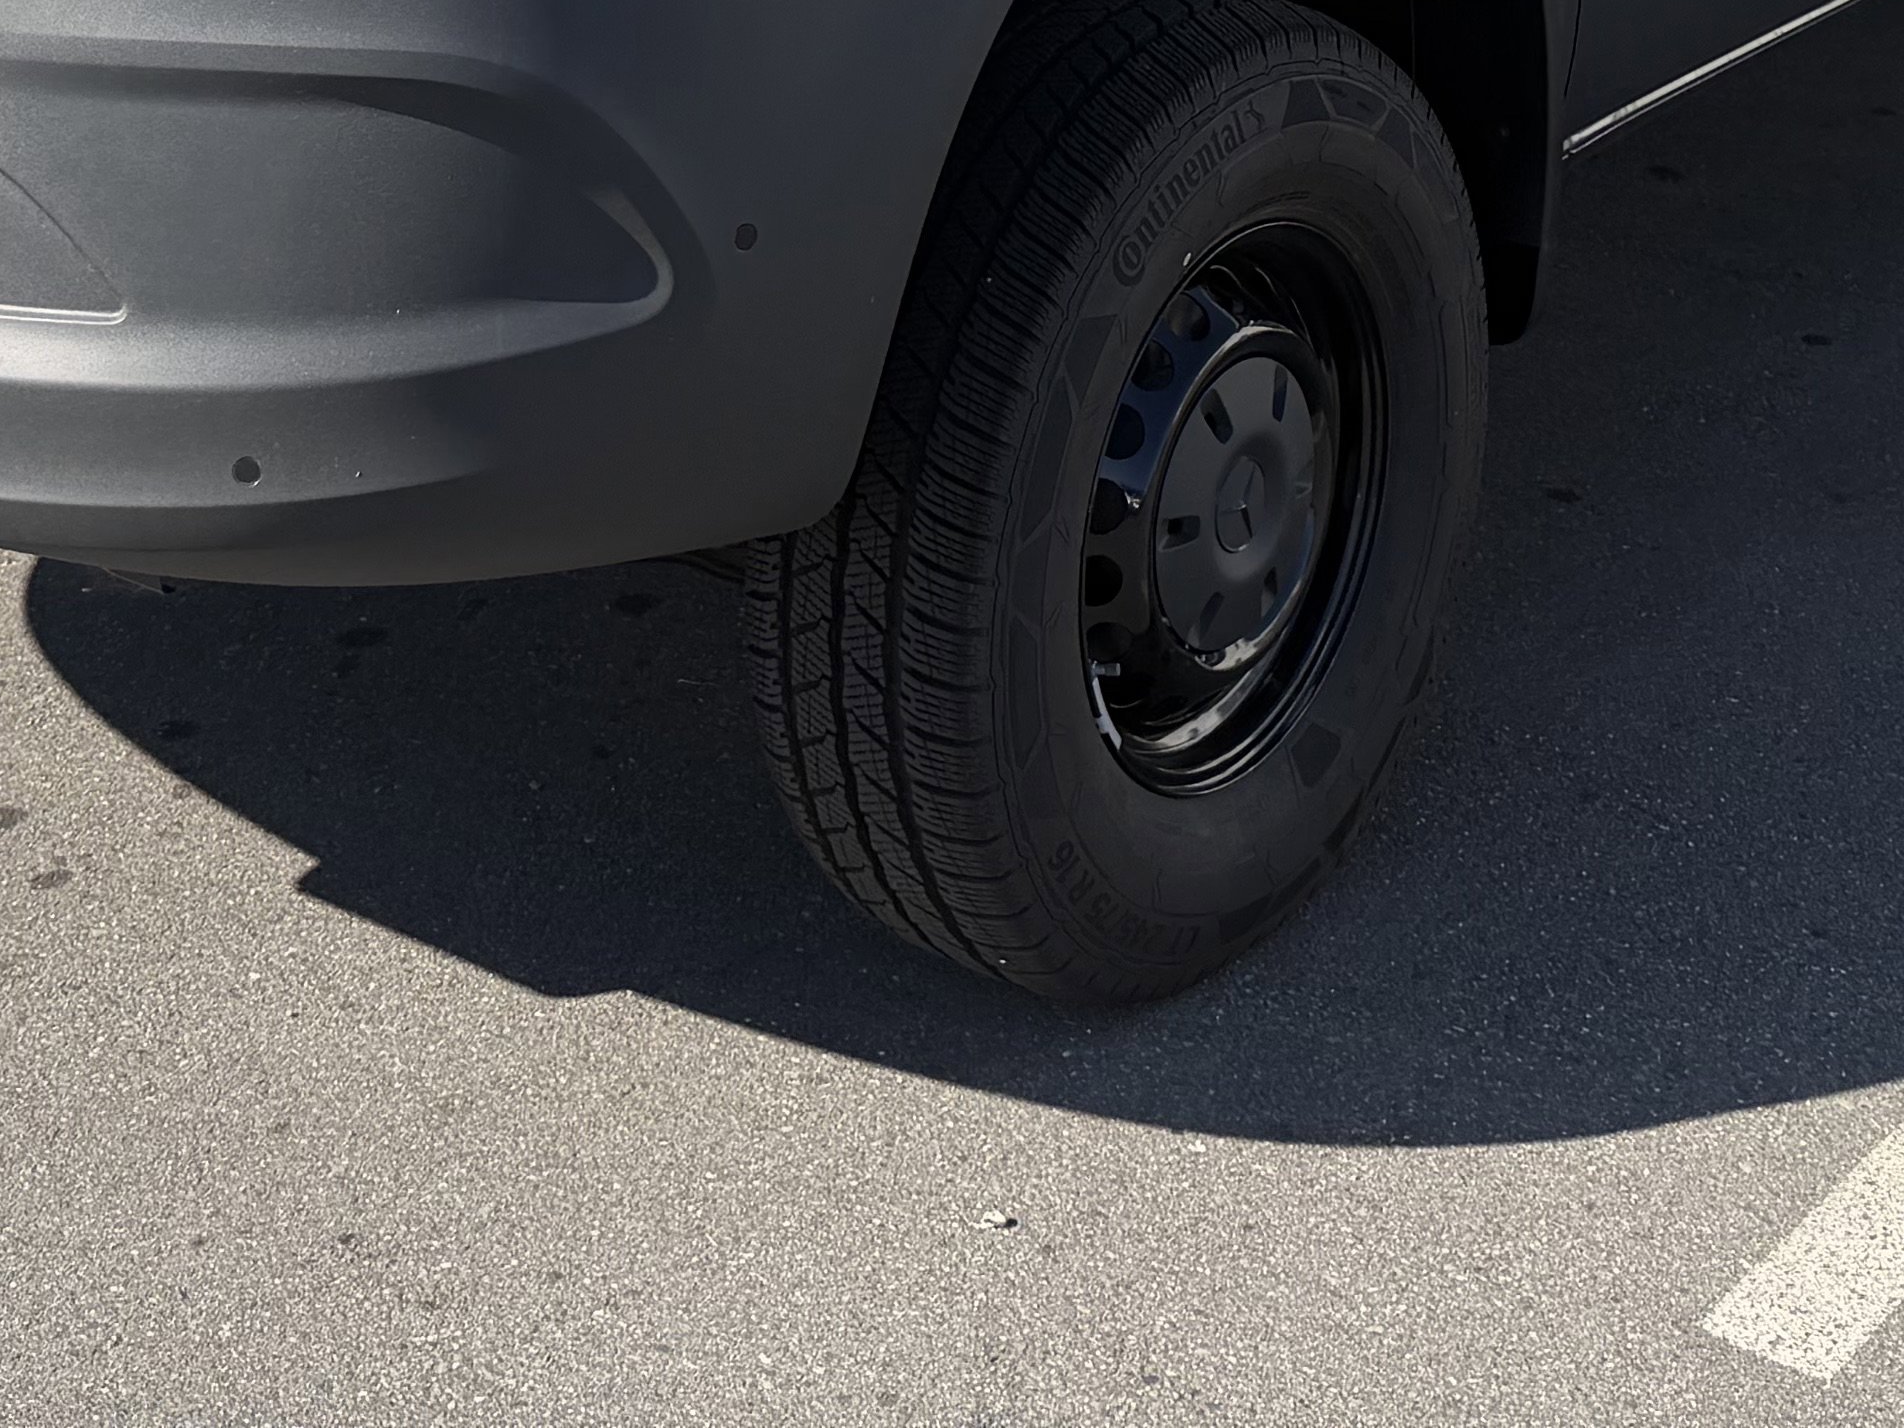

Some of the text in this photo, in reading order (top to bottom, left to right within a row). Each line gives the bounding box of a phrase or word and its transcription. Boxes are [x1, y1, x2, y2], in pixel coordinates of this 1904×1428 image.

[1112, 110, 1246, 287] Continental
[1047, 839, 1081, 884] 16
[1067, 868, 1095, 905] R
